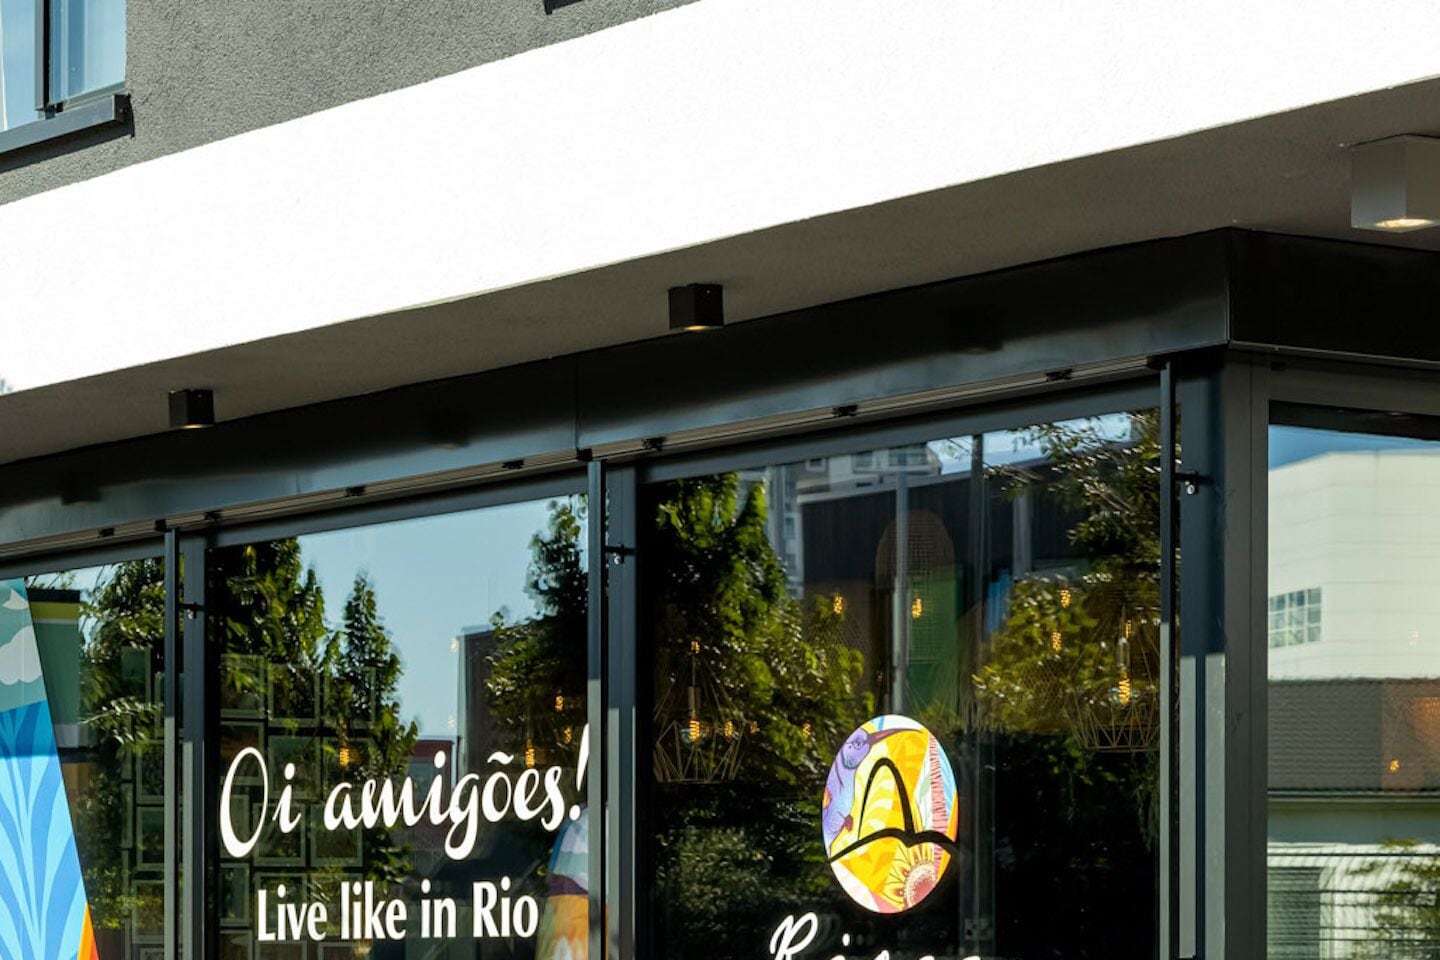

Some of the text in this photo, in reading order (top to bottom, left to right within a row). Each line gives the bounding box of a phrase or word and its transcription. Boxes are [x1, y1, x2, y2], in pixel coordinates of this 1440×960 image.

[220, 723, 589, 860] Oi amigões!
[257, 876, 539, 941] Live like in Rio
